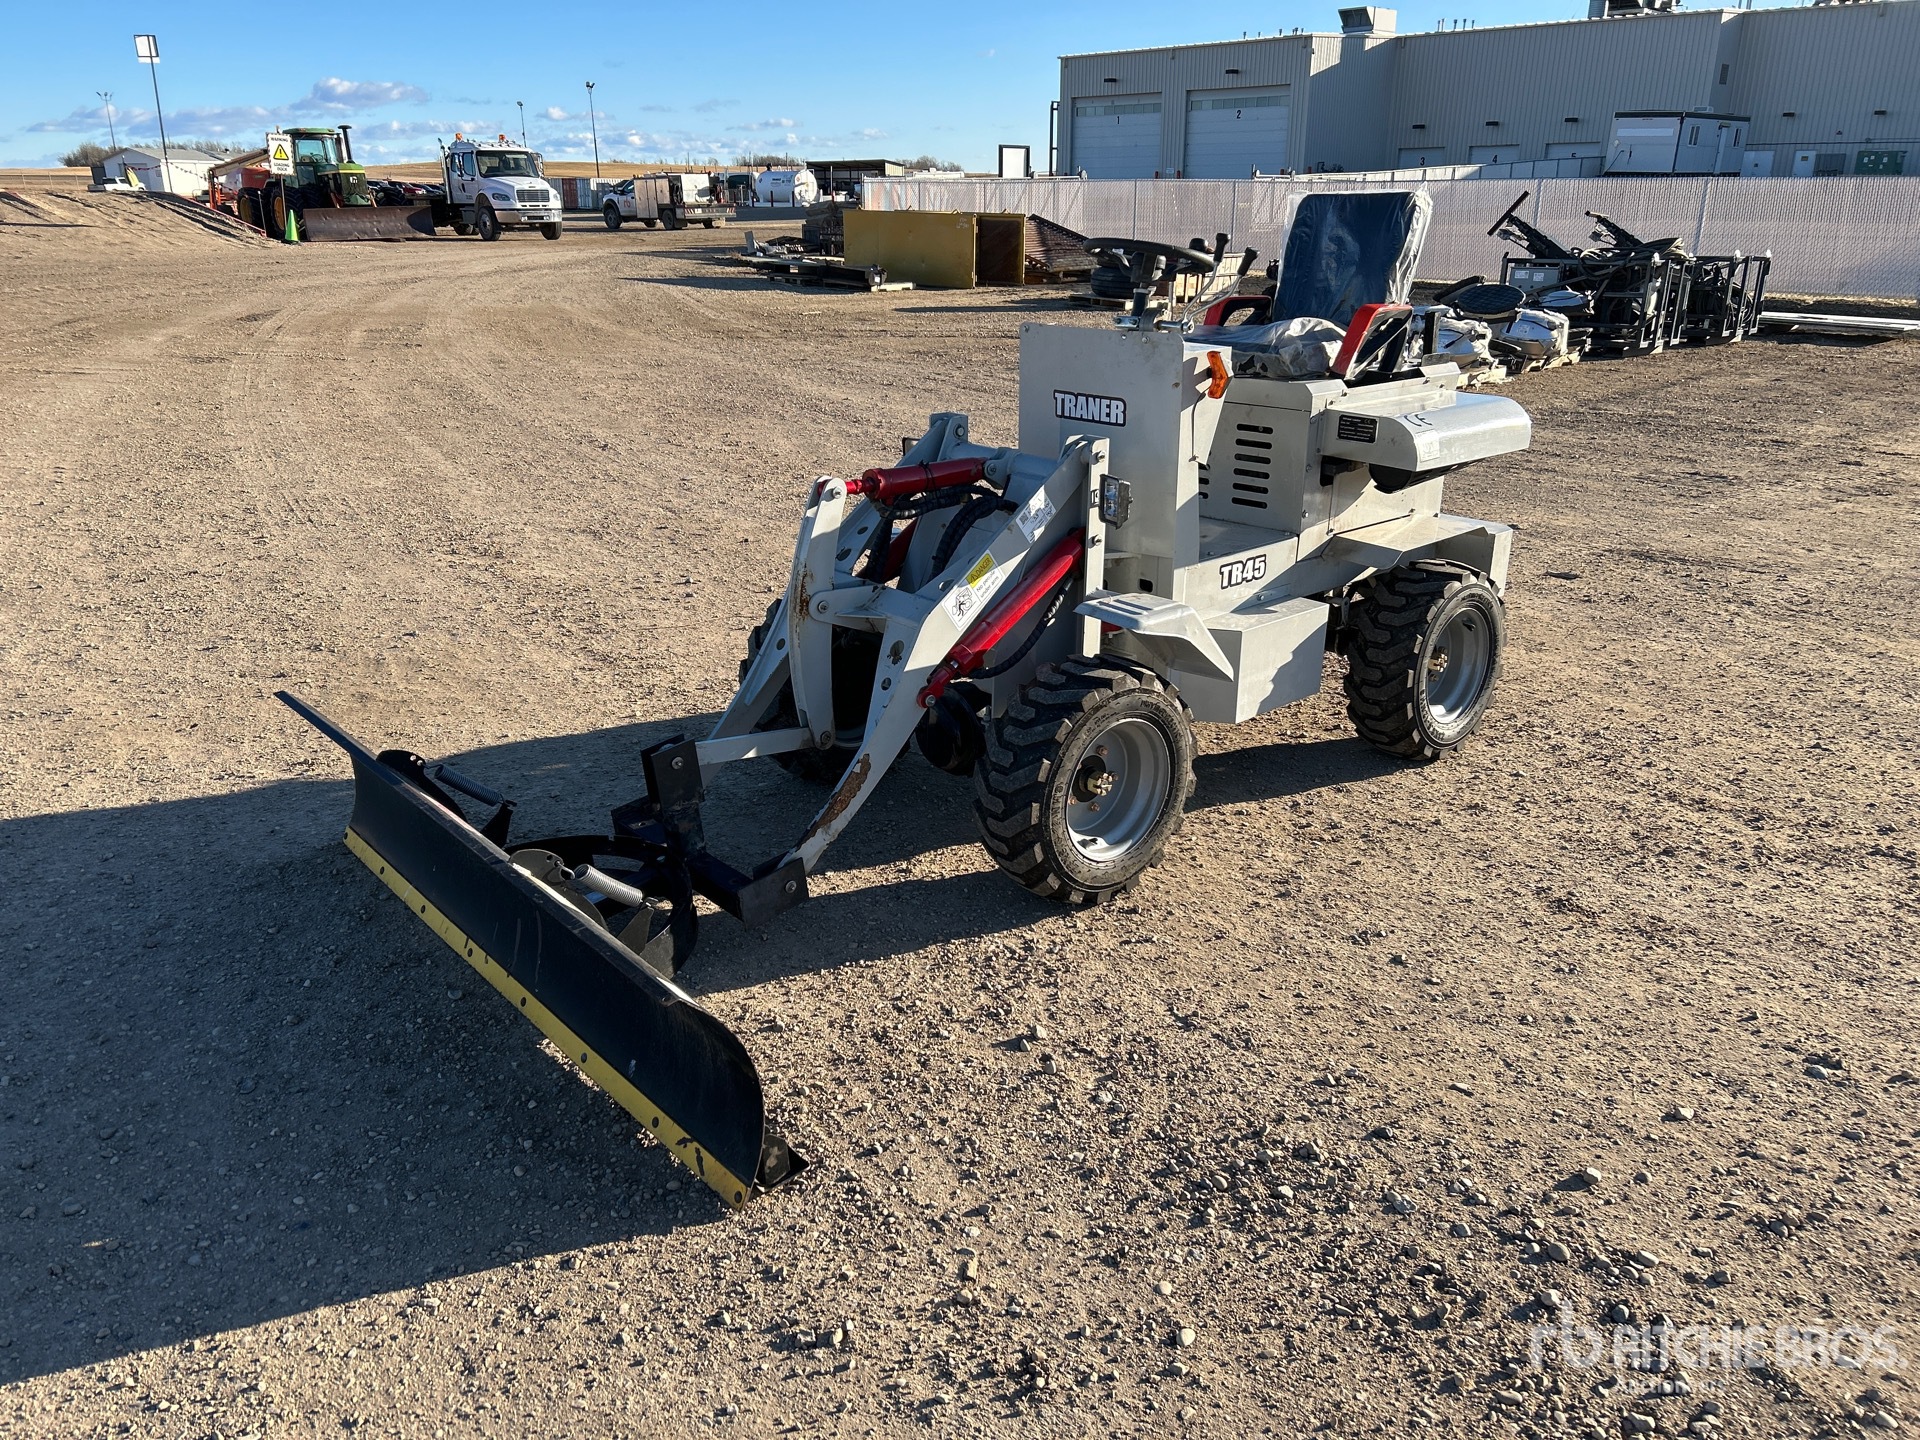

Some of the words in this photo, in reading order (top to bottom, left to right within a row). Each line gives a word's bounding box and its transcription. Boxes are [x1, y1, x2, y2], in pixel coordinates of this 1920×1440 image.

[1236, 109, 1242, 120] 2
[1420, 156, 1426, 166] 3
[1492, 154, 1498, 164] 4
[1054, 391, 1125, 425] TRANER
[976, 557, 993, 576] DANGER
[1220, 555, 1266, 588] TR45
